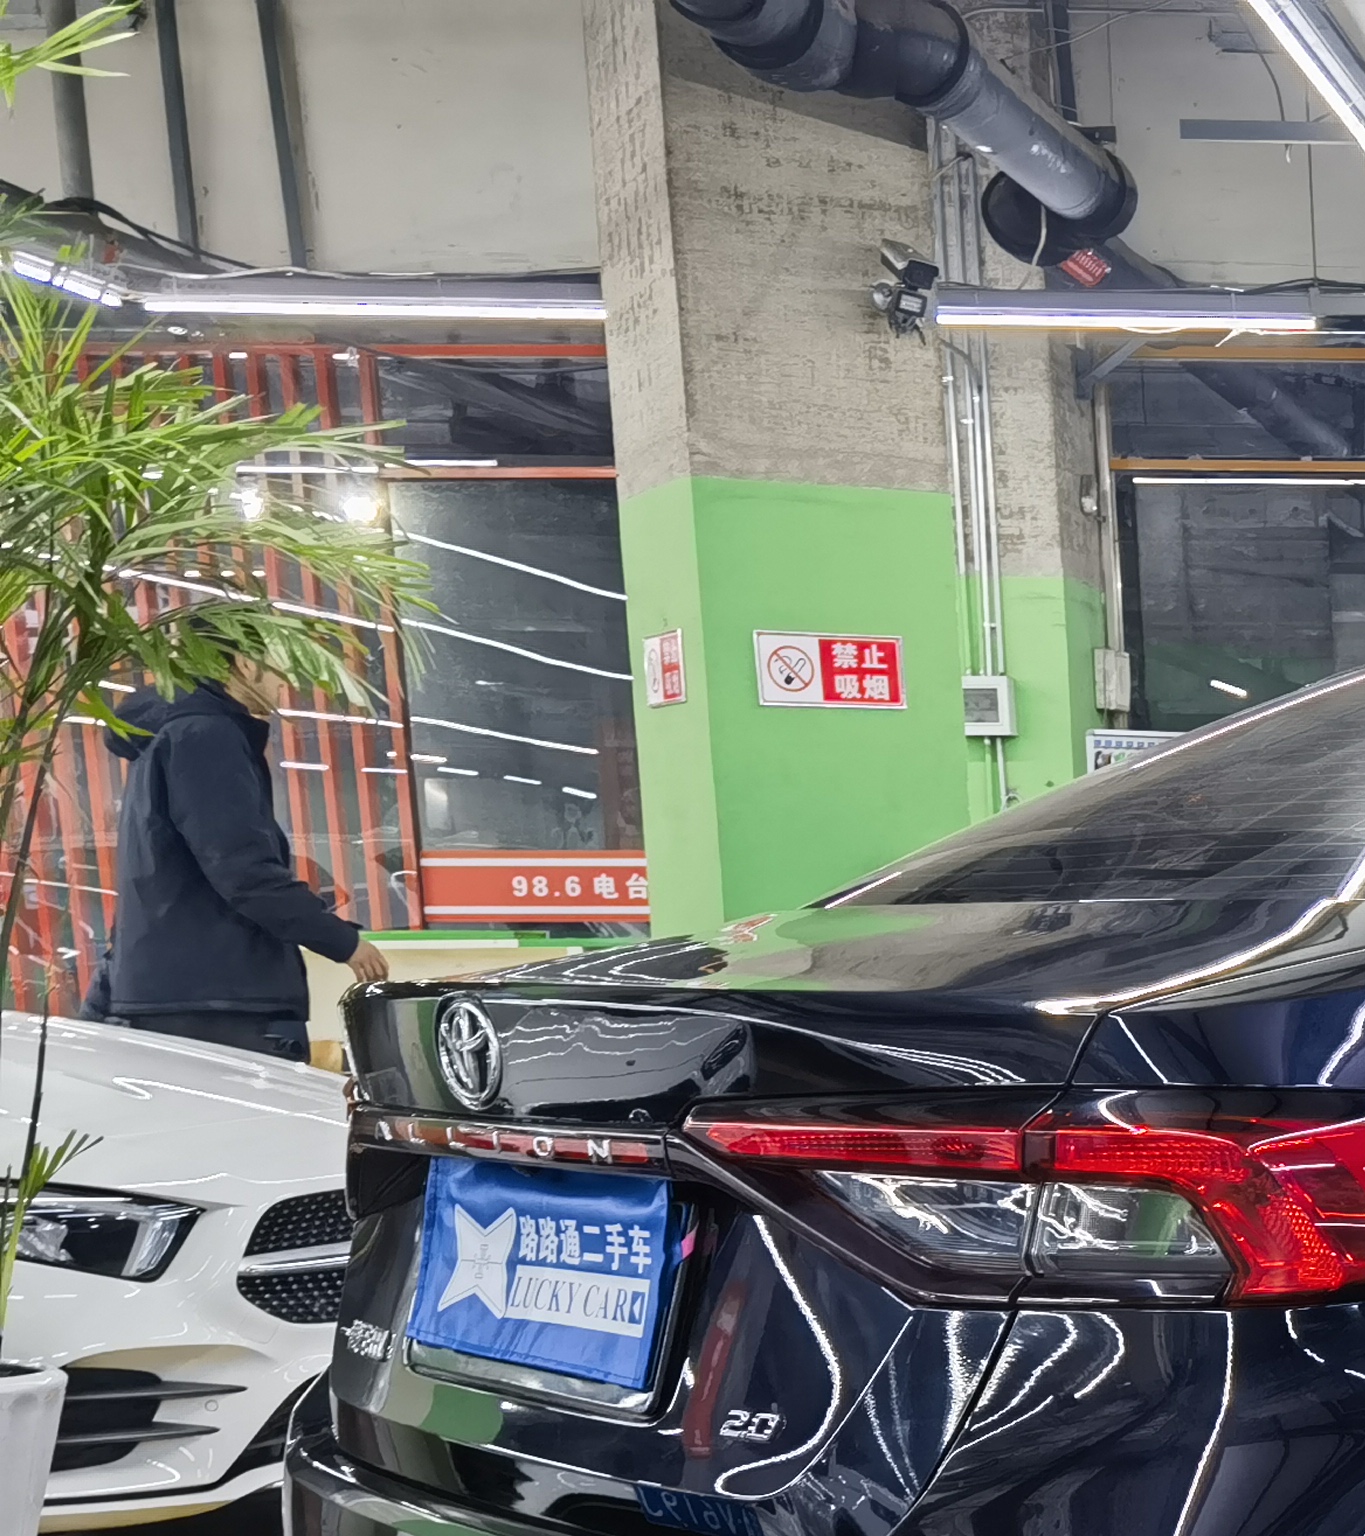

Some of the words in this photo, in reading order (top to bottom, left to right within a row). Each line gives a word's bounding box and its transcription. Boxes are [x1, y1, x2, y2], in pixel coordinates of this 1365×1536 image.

[831, 643, 888, 669] 禁止
[834, 674, 890, 700] 吸烟
[511, 875, 582, 898] 98.6
[592, 872, 649, 900] 电台
[375, 1119, 612, 1164] ALLION
[518, 1215, 652, 1274] 路路通二手车
[510, 1276, 583, 1315] LUCKY
[582, 1285, 630, 1324] CAR
